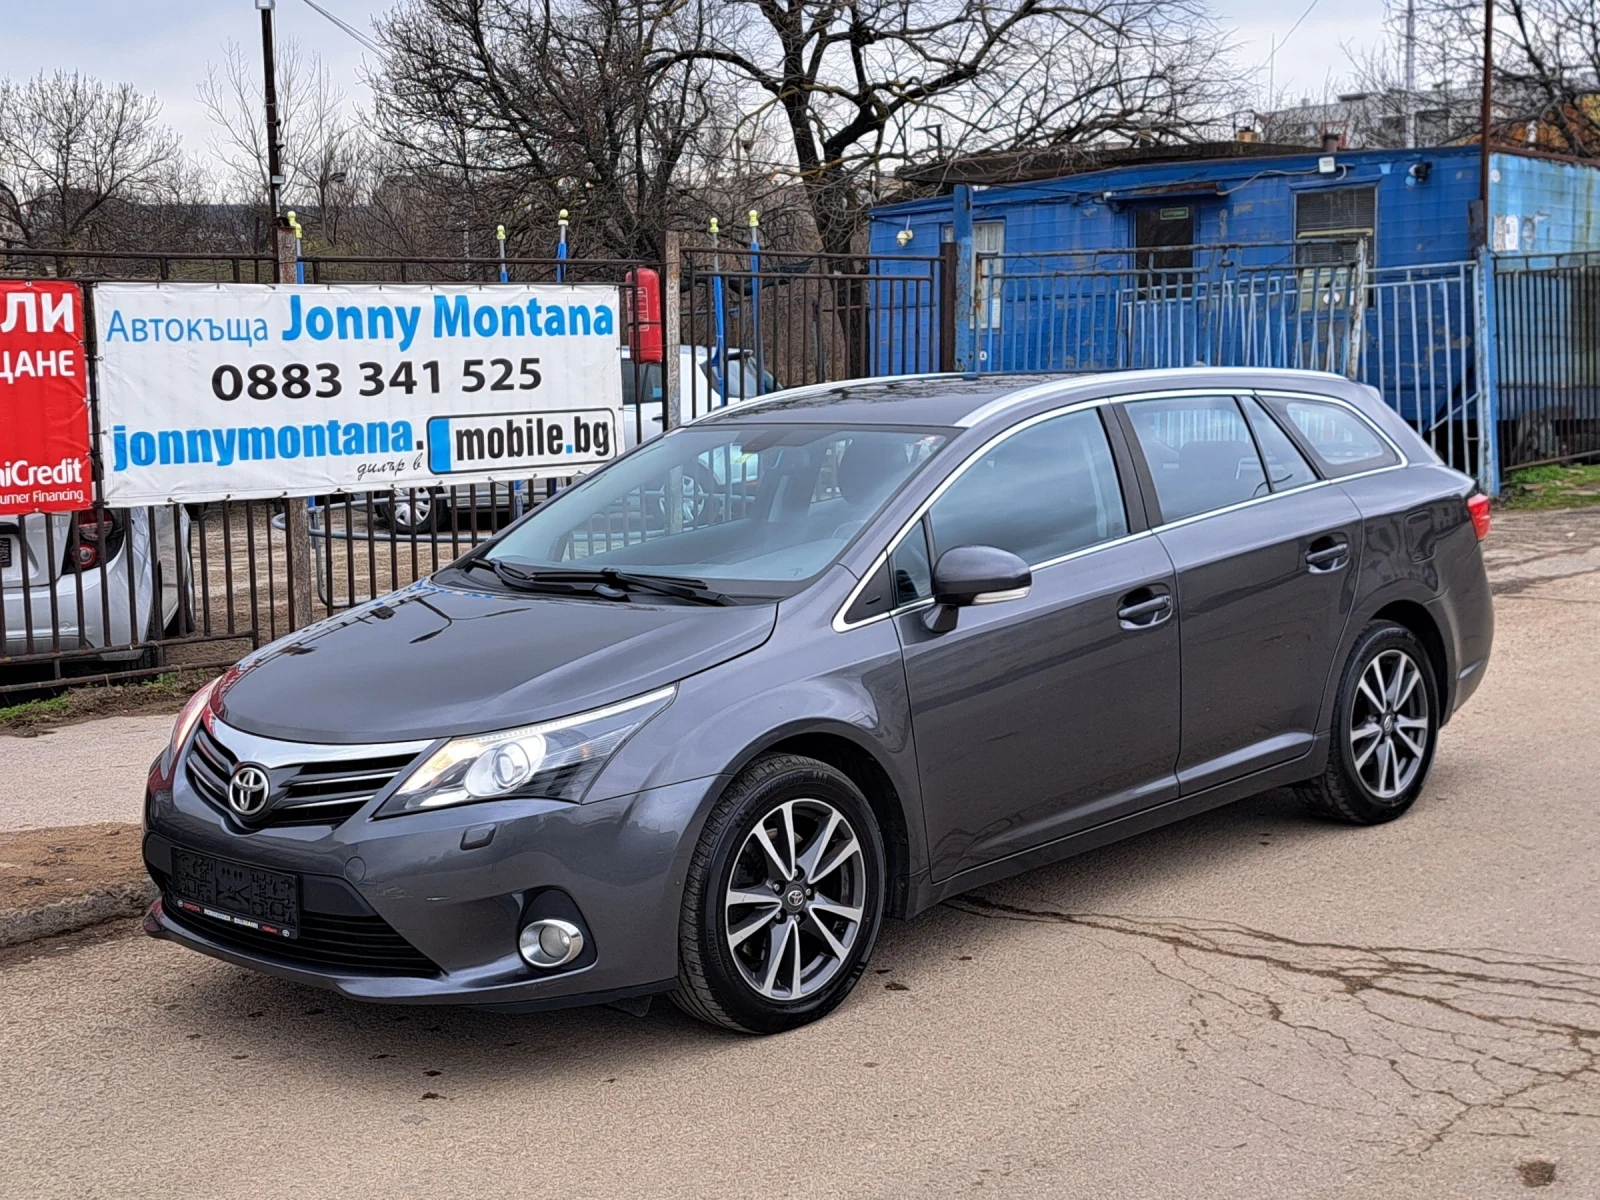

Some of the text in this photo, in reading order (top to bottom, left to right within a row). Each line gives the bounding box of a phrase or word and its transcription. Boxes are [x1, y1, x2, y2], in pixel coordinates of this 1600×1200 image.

[106, 309, 268, 347] Автокъща
[281, 294, 422, 353] Jonny
[433, 294, 613, 338] Montana
[211, 357, 542, 401] 0883 341 525
[455, 416, 609, 461] mobile.bg
[32, 487, 84, 503] Financing
